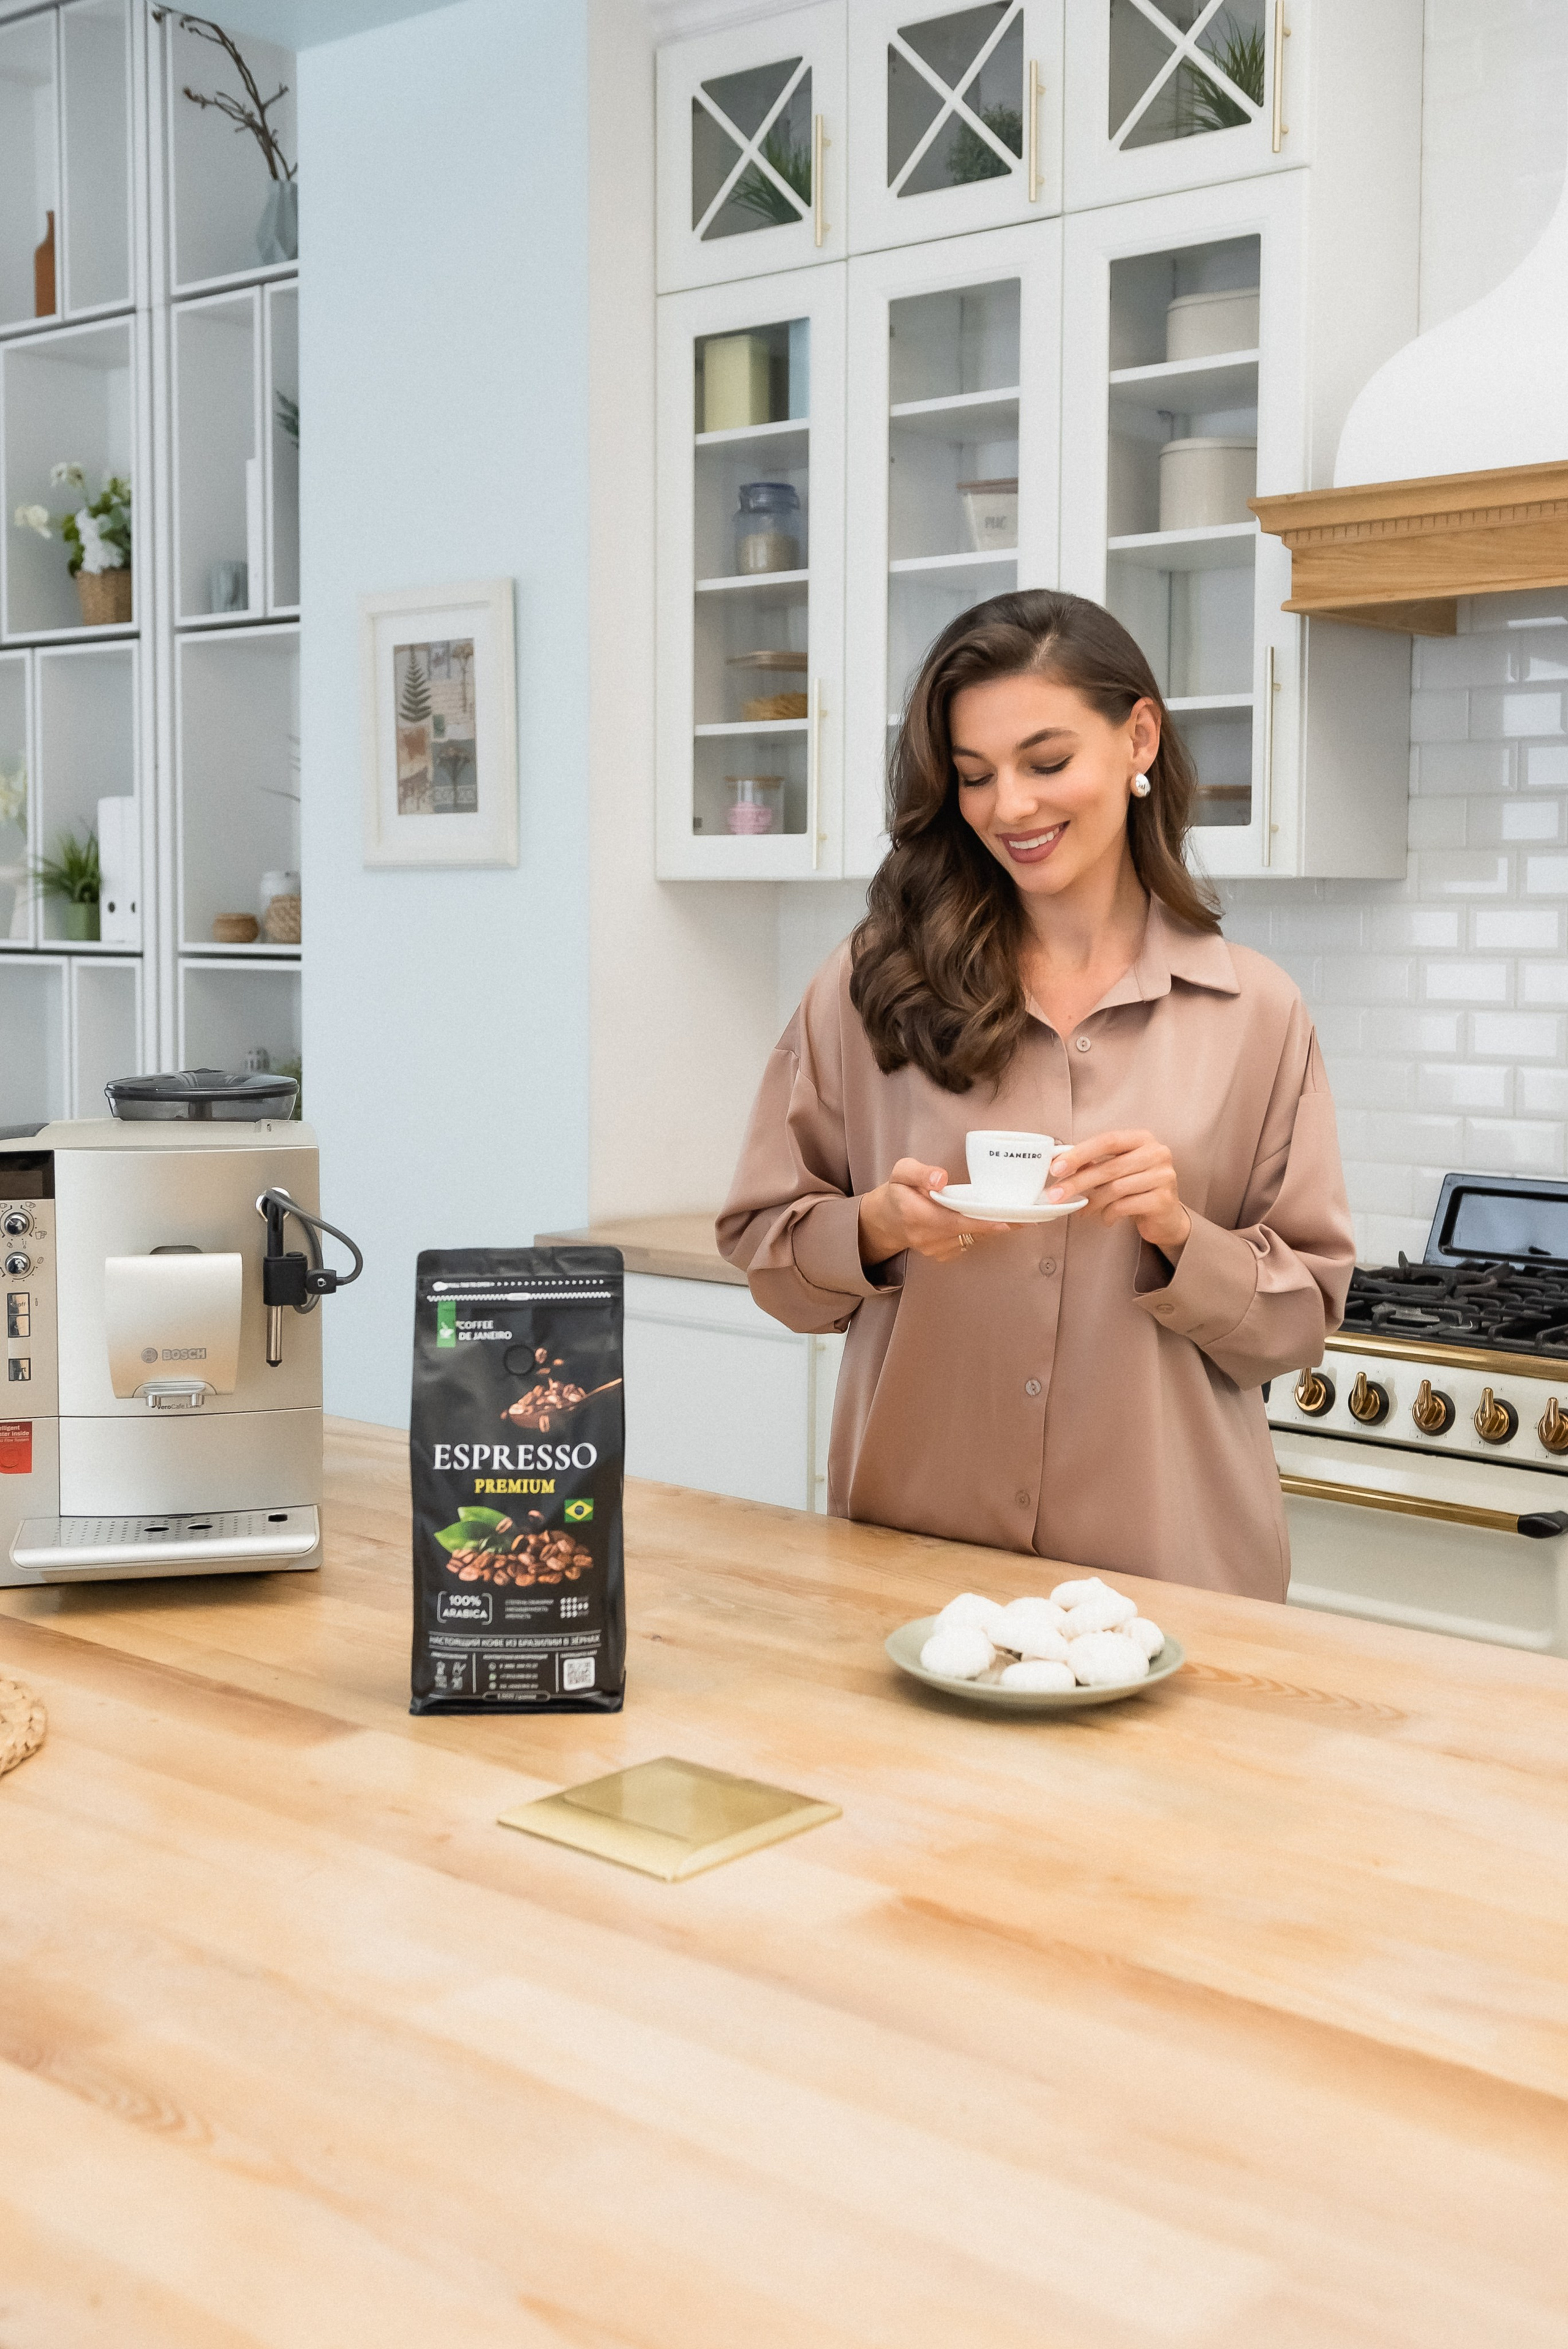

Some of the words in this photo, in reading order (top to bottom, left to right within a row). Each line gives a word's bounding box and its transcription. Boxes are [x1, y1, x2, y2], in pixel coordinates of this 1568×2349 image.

[458, 1320, 494, 1330] COFFEE
[458, 1332, 472, 1341] DE
[473, 1330, 513, 1340] JANEIRO
[162, 1348, 206, 1361] BOSCH
[433, 1442, 597, 1471] ESPRESSO
[473, 1479, 556, 1494] PREMIUM
[449, 1594, 481, 1607] 100%
[442, 1608, 488, 1619] ARABICA
[481, 1638, 504, 1647] КОФЕ
